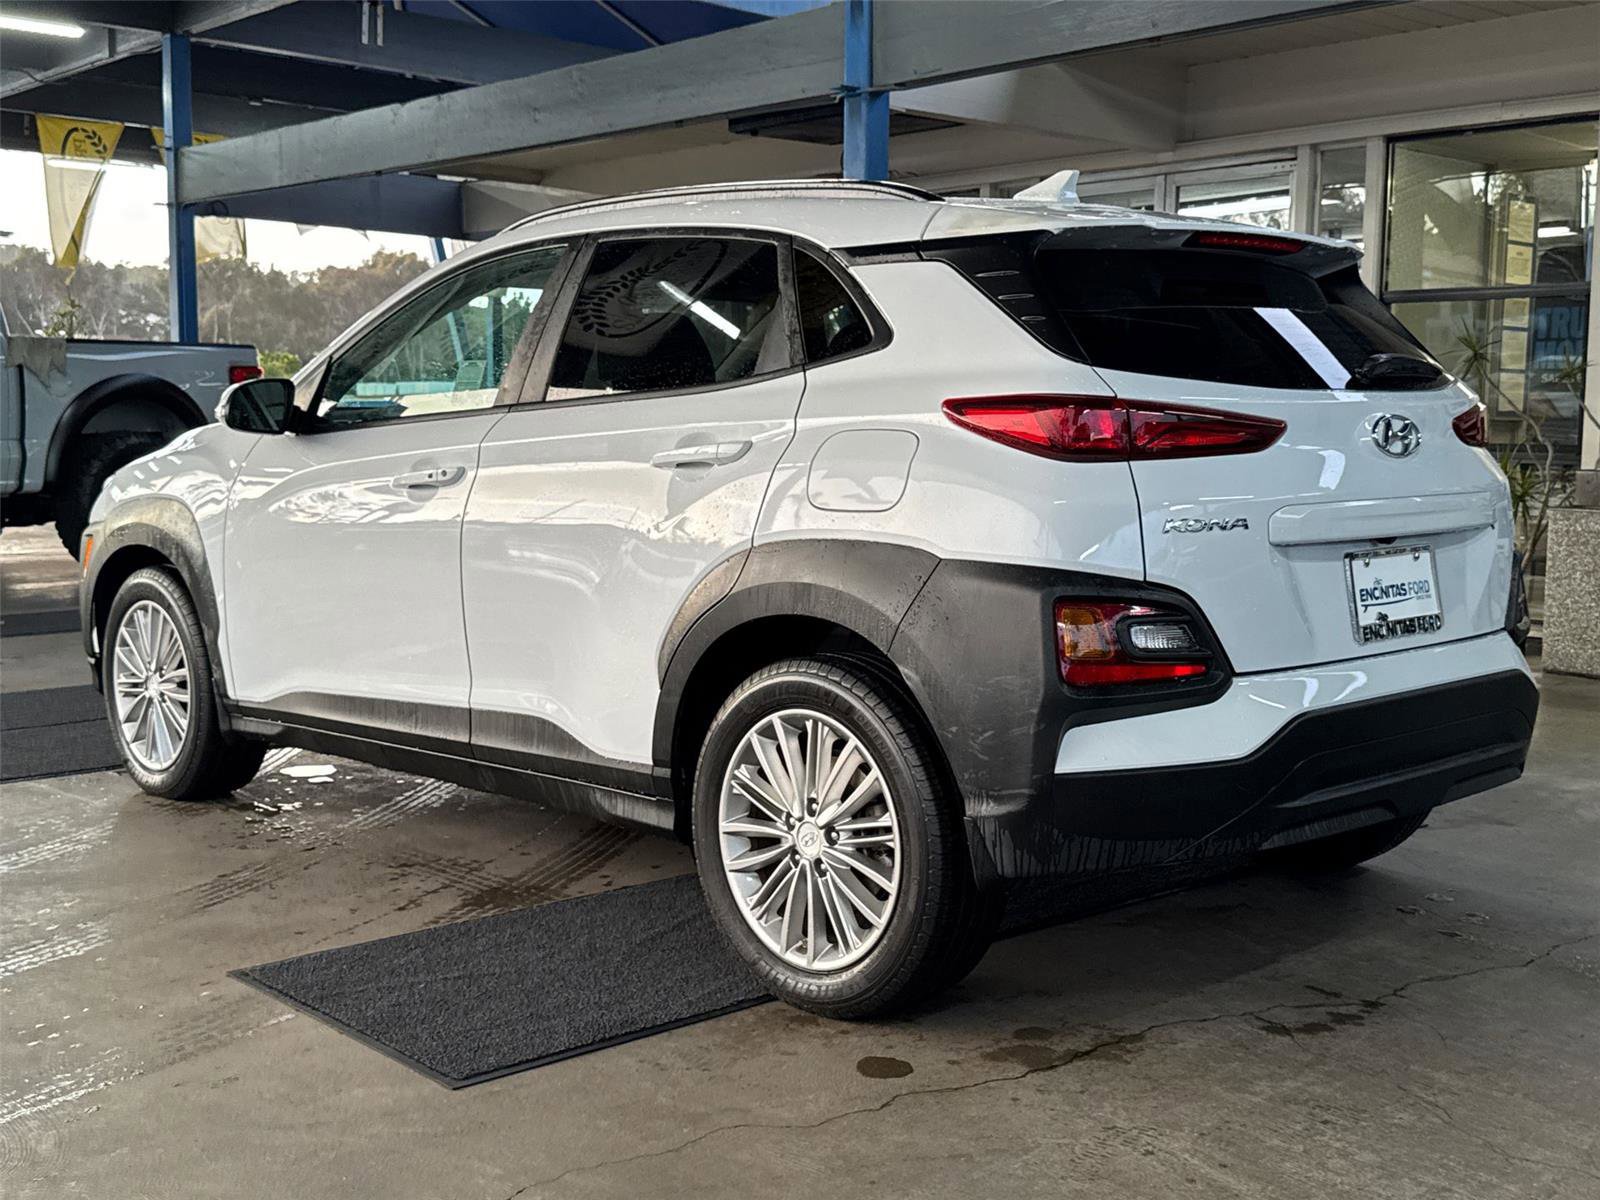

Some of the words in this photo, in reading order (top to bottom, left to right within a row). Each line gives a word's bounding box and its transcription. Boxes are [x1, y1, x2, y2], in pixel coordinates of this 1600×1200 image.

[1162, 518, 1249, 534] KONA
[1407, 579, 1430, 596] FORD
[1362, 618, 1417, 642] ENCNITAS
[1417, 613, 1441, 634] FORD
